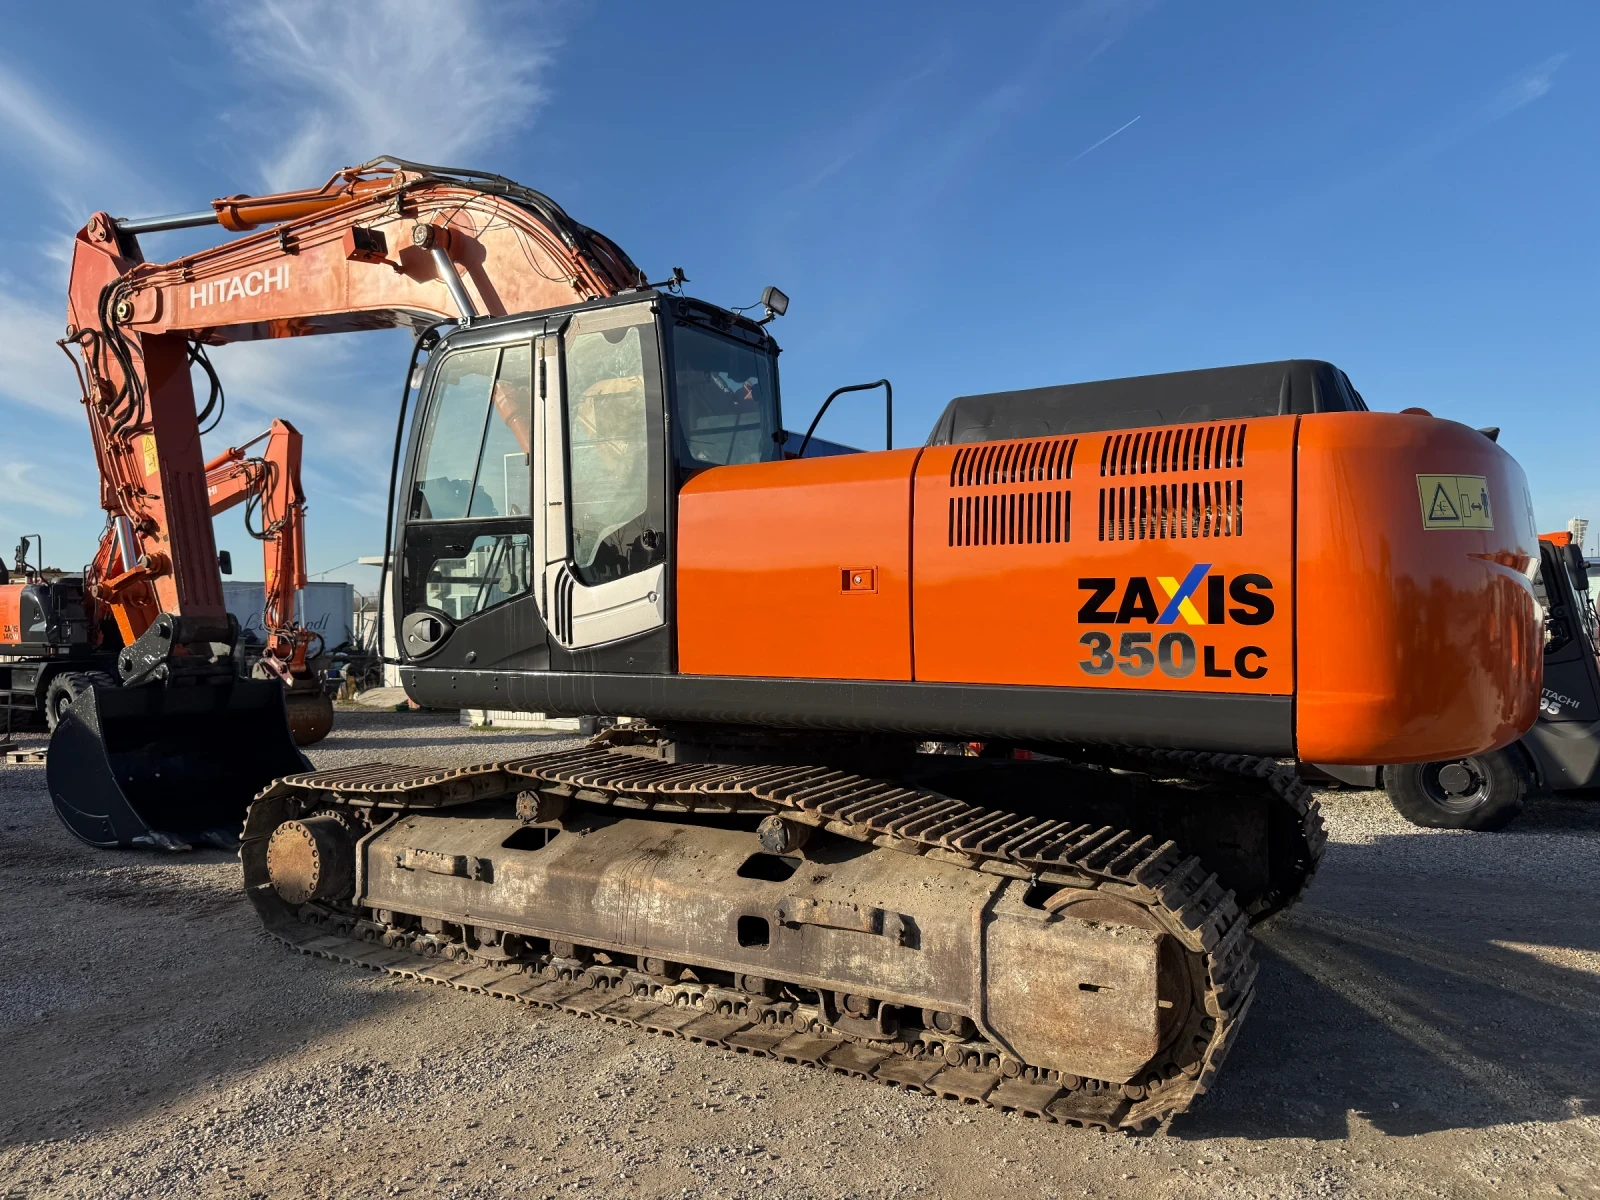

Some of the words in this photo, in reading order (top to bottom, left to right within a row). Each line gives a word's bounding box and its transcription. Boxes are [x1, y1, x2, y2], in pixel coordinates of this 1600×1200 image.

[190, 263, 290, 310] HITACHI
[1077, 563, 1275, 626] ZAXIS
[1541, 687, 1581, 709] ITACHI
